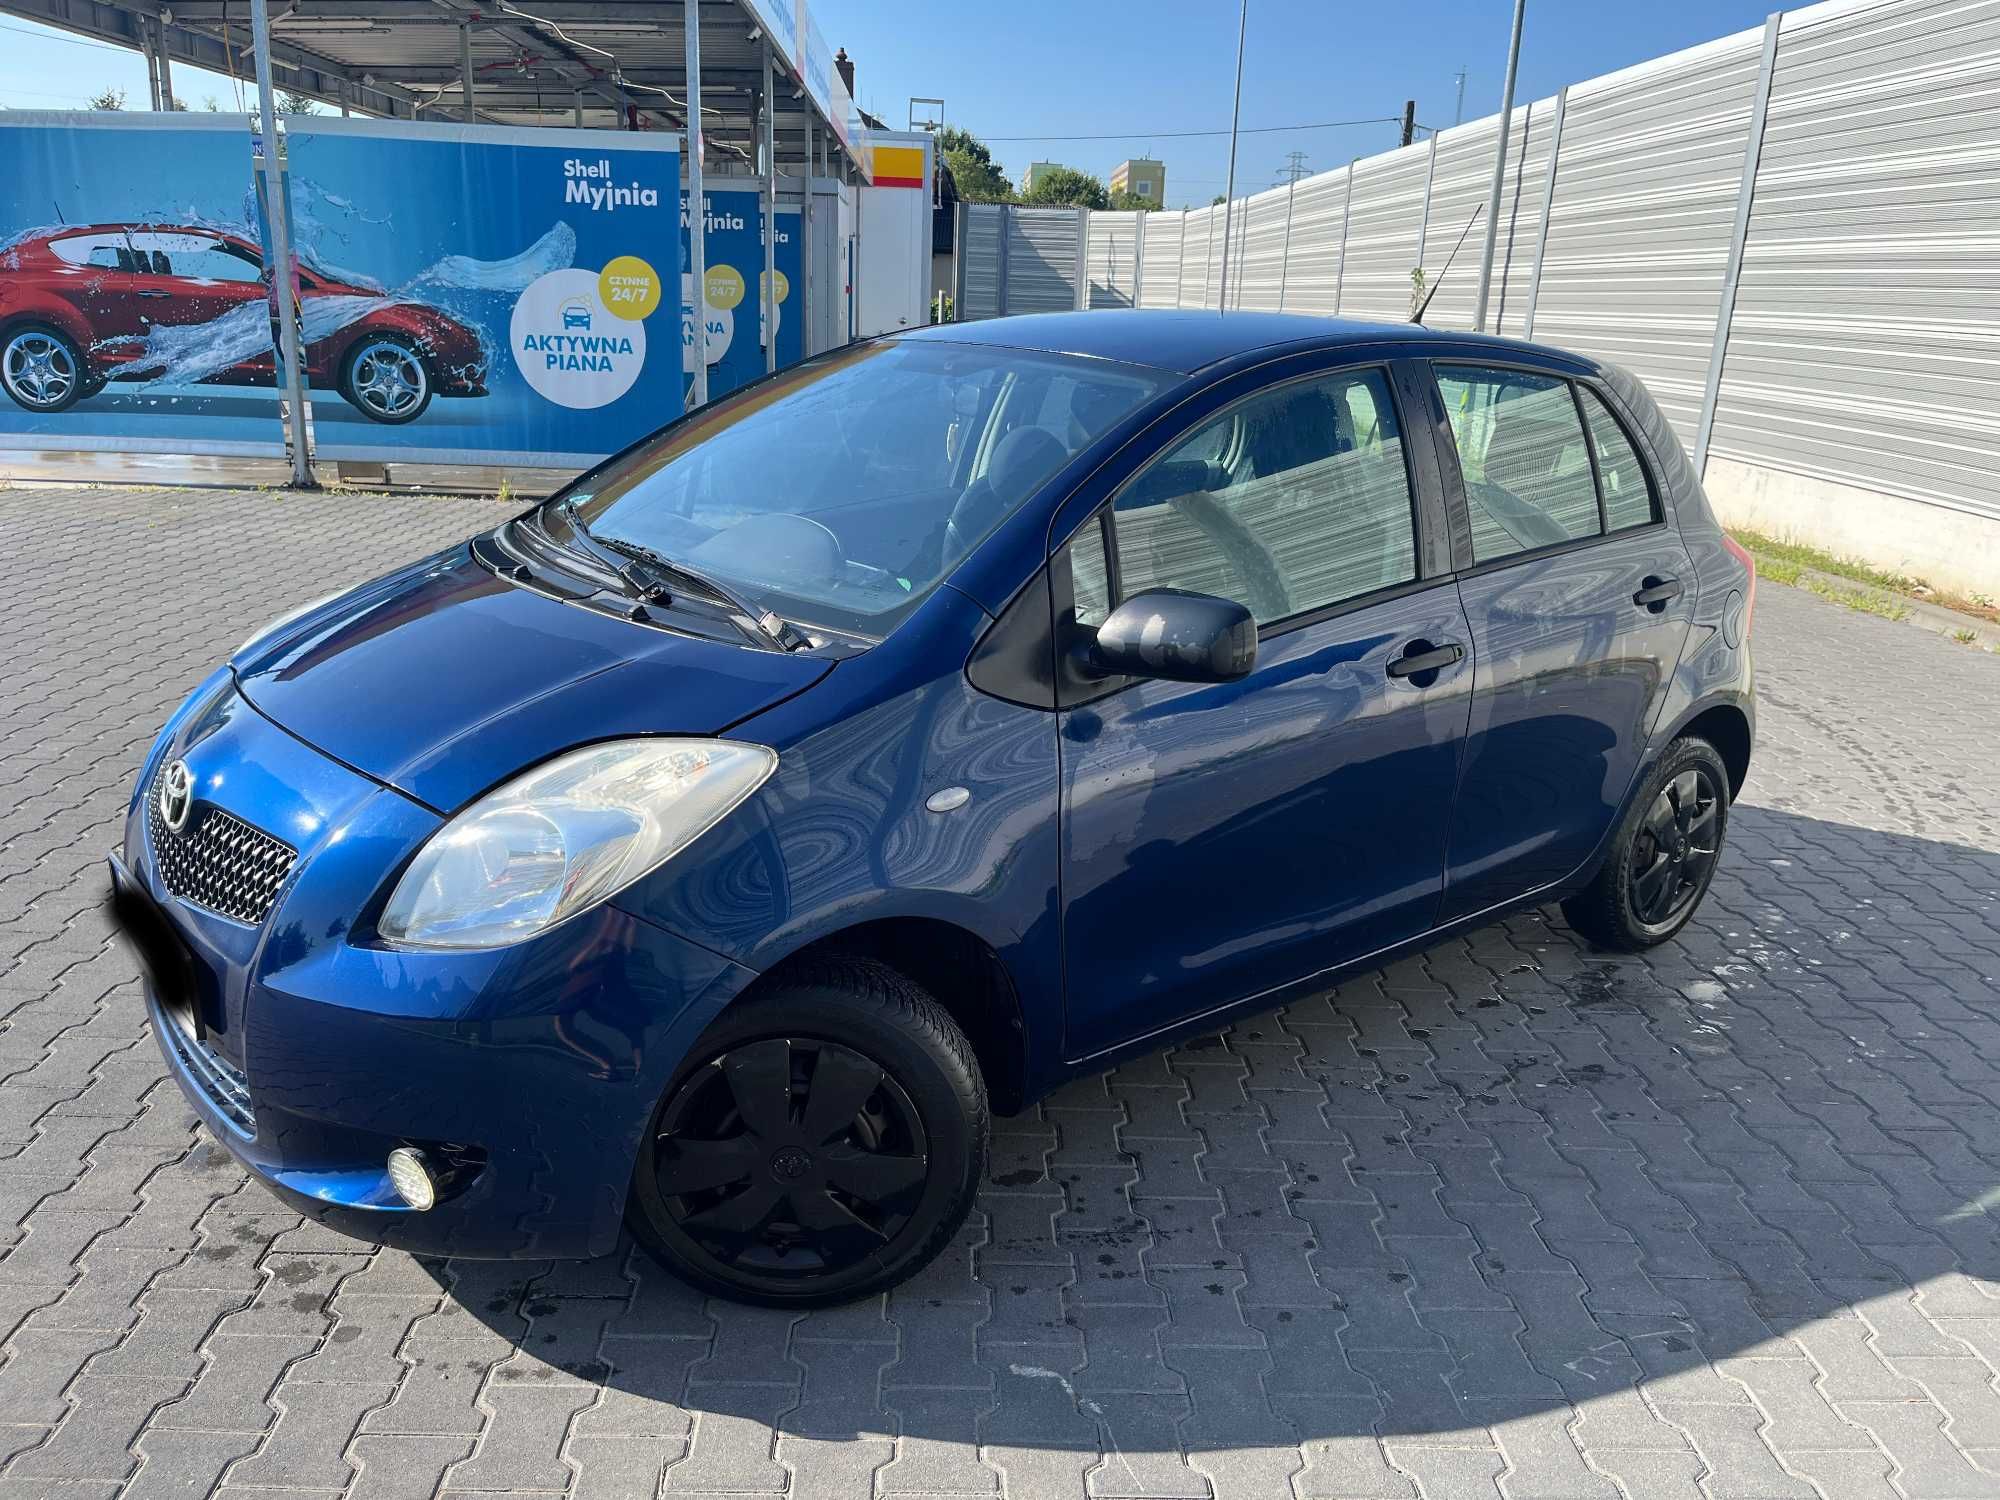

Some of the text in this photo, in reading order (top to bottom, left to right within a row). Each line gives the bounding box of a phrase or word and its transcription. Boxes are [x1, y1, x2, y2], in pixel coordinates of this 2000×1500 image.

[564, 159, 610, 178] Shell
[565, 180, 658, 211] Myjnia
[608, 276, 650, 286] CZYNNE
[611, 287, 649, 303] 24/7
[710, 286, 737, 297] 24/7
[523, 334, 634, 354] AKTYWNA
[546, 353, 614, 373] PIANA
